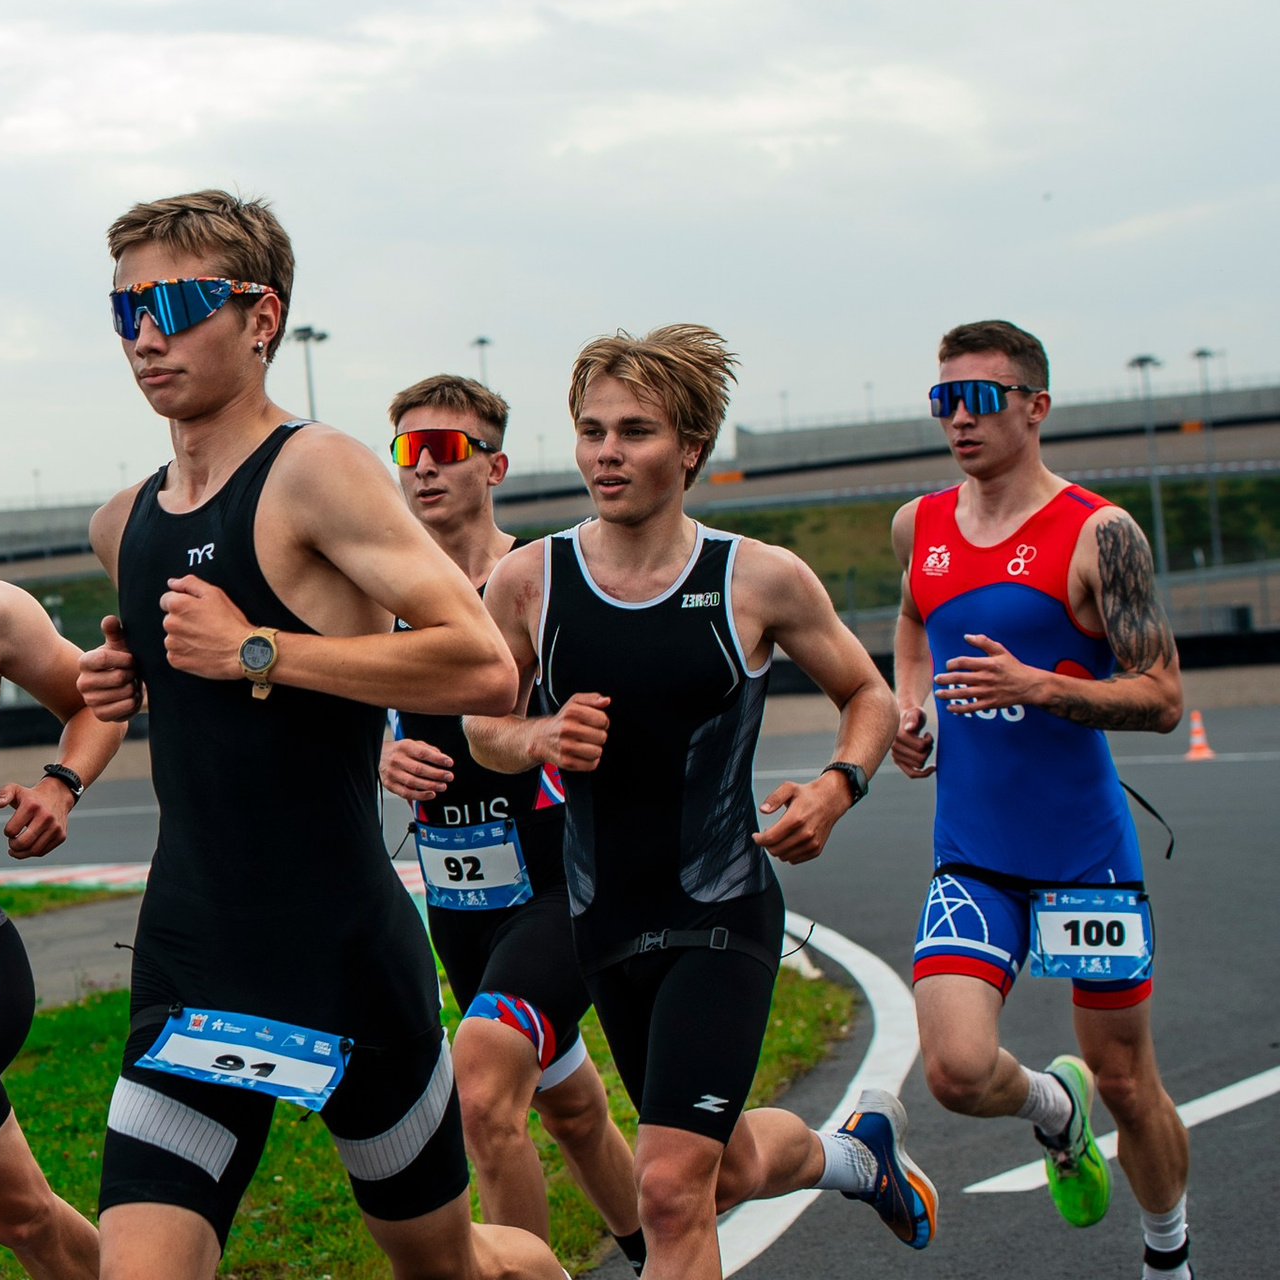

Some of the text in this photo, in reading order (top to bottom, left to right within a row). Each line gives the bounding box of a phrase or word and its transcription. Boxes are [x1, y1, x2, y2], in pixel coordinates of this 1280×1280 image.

[187, 542, 215, 567] TYR
[444, 855, 485, 882] 92
[1062, 919, 1127, 947] 100
[211, 1054, 277, 1078] 91
